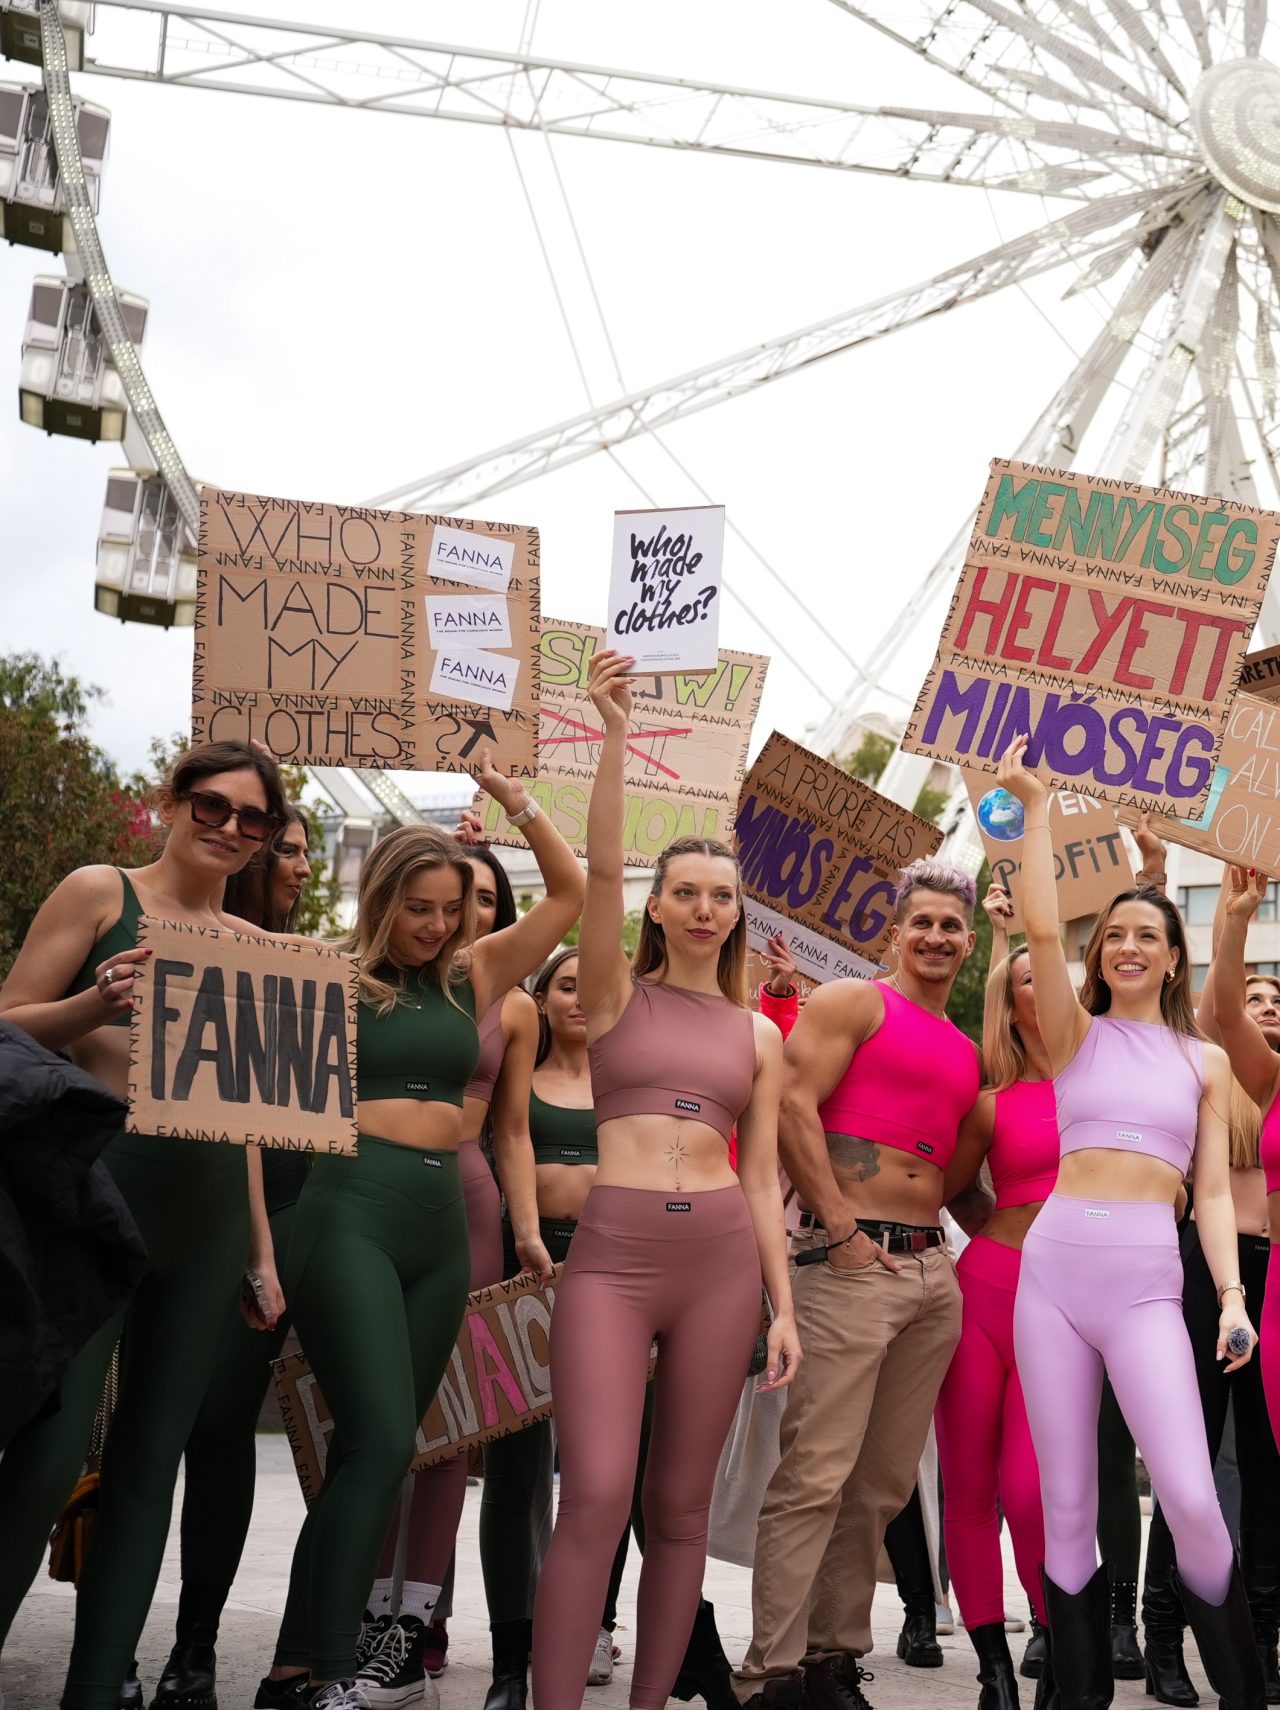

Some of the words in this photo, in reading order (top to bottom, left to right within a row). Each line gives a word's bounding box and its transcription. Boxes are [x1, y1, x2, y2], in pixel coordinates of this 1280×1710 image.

[1021, 461, 1077, 481] FANNA
[1086, 474, 1143, 494] FANNA
[256, 496, 325, 516] FANNA
[1152, 486, 1209, 506] FANNA
[220, 504, 382, 565] WHO
[985, 473, 1260, 587] MENNYISÉG
[276, 558, 342, 577] FANNA
[400, 532, 416, 590] FANNA
[437, 542, 504, 571] FANNA
[630, 534, 703, 583] made
[1020, 547, 1077, 573] FANNA
[1086, 562, 1143, 588] FANNA
[1152, 577, 1211, 602] FANNA
[217, 573, 400, 639] MADE
[529, 577, 541, 633] FANNA
[640, 578, 682, 606] my
[433, 611, 502, 628] FANNA
[614, 585, 718, 636] clothes?
[1224, 651, 1248, 707] FANNA
[1257, 537, 1280, 593] FANNA
[400, 600, 416, 660] FANNA
[953, 565, 1248, 702] HELYETT
[192, 642, 206, 704] FANNA
[267, 635, 359, 690] MY
[440, 657, 507, 689] FANNA
[269, 693, 338, 710] FANNA
[400, 670, 416, 730] FANNA
[949, 652, 1008, 679] FANNA
[1016, 667, 1075, 692] FANNA
[1083, 682, 1143, 707] FANNA
[1151, 696, 1212, 722] FANNA
[427, 701, 491, 720] FANNA
[632, 702, 684, 720] FANNA
[691, 711, 742, 729] FANNA
[921, 669, 1216, 799] MINŐSÉG
[734, 741, 751, 782] FANNA
[764, 753, 792, 788] A
[794, 743, 831, 770] FANNA
[678, 785, 730, 802] FANNA
[755, 778, 794, 809] FANNA
[832, 767, 870, 793] FANNA
[1049, 777, 1108, 801] FANNA
[1117, 792, 1178, 818] FANNA
[796, 802, 835, 834] FANNA
[1215, 803, 1272, 861] ON
[837, 826, 875, 856] FANNA
[812, 866, 842, 907] FANNA
[789, 936, 829, 966] FANNA
[348, 956, 362, 1025] FANNA
[150, 957, 355, 1120] FANNA
[407, 1083, 428, 1091] FANNA
[676, 1101, 699, 1112] FANNA
[1117, 1132, 1141, 1141] FANNA
[424, 1157, 442, 1167] FANNA
[667, 1203, 689, 1211] FANNA
[1086, 1210, 1108, 1219] FANNA
[277, 1394, 305, 1461] FANNA
